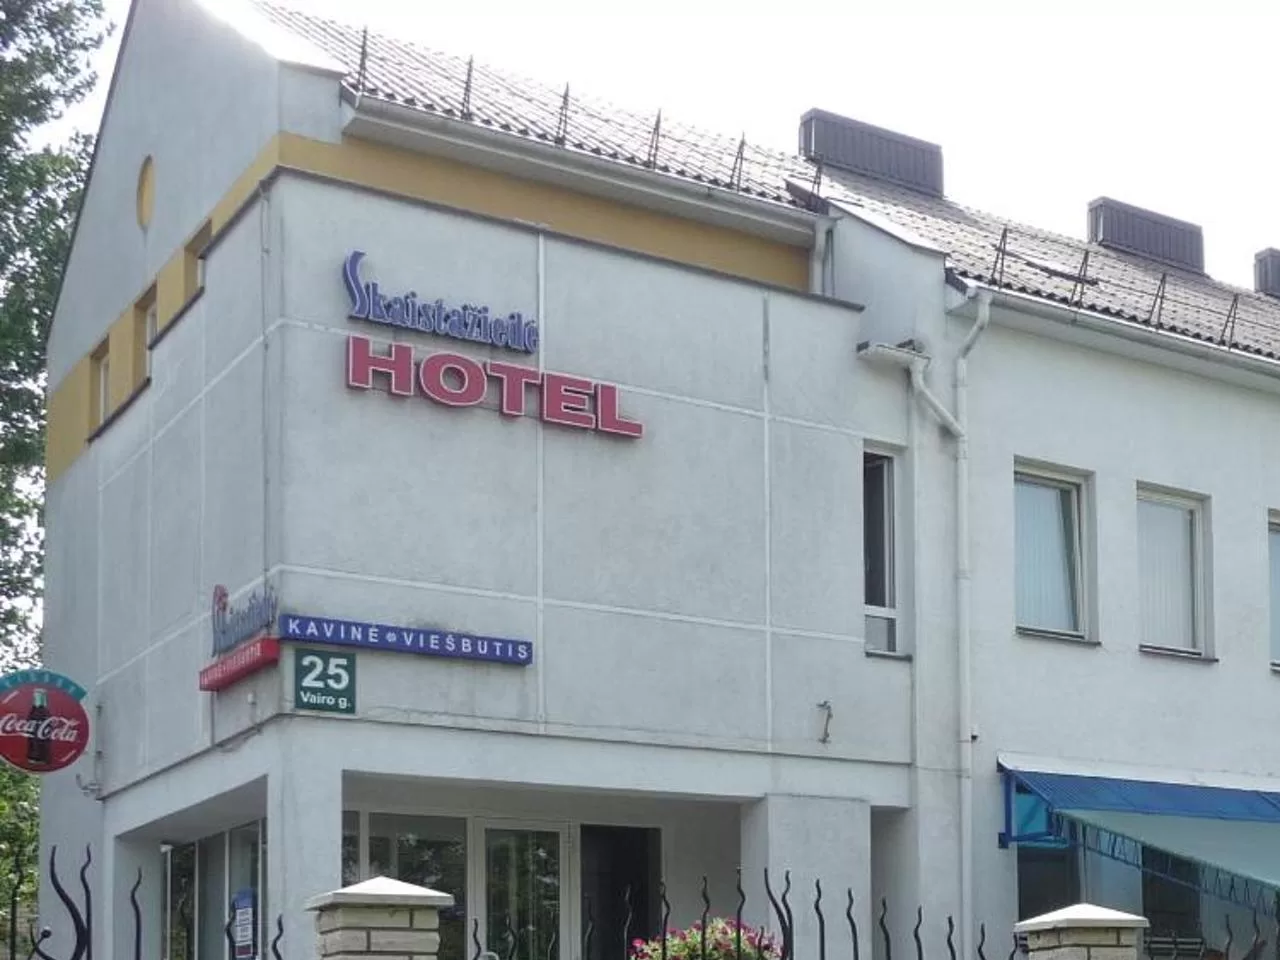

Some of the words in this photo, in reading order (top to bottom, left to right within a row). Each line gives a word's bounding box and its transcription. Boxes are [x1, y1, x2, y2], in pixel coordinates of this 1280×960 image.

[347, 335, 643, 437] HOTEL
[301, 655, 350, 690] 25
[300, 690, 335, 706] Vairo
[337, 694, 351, 708] g.
